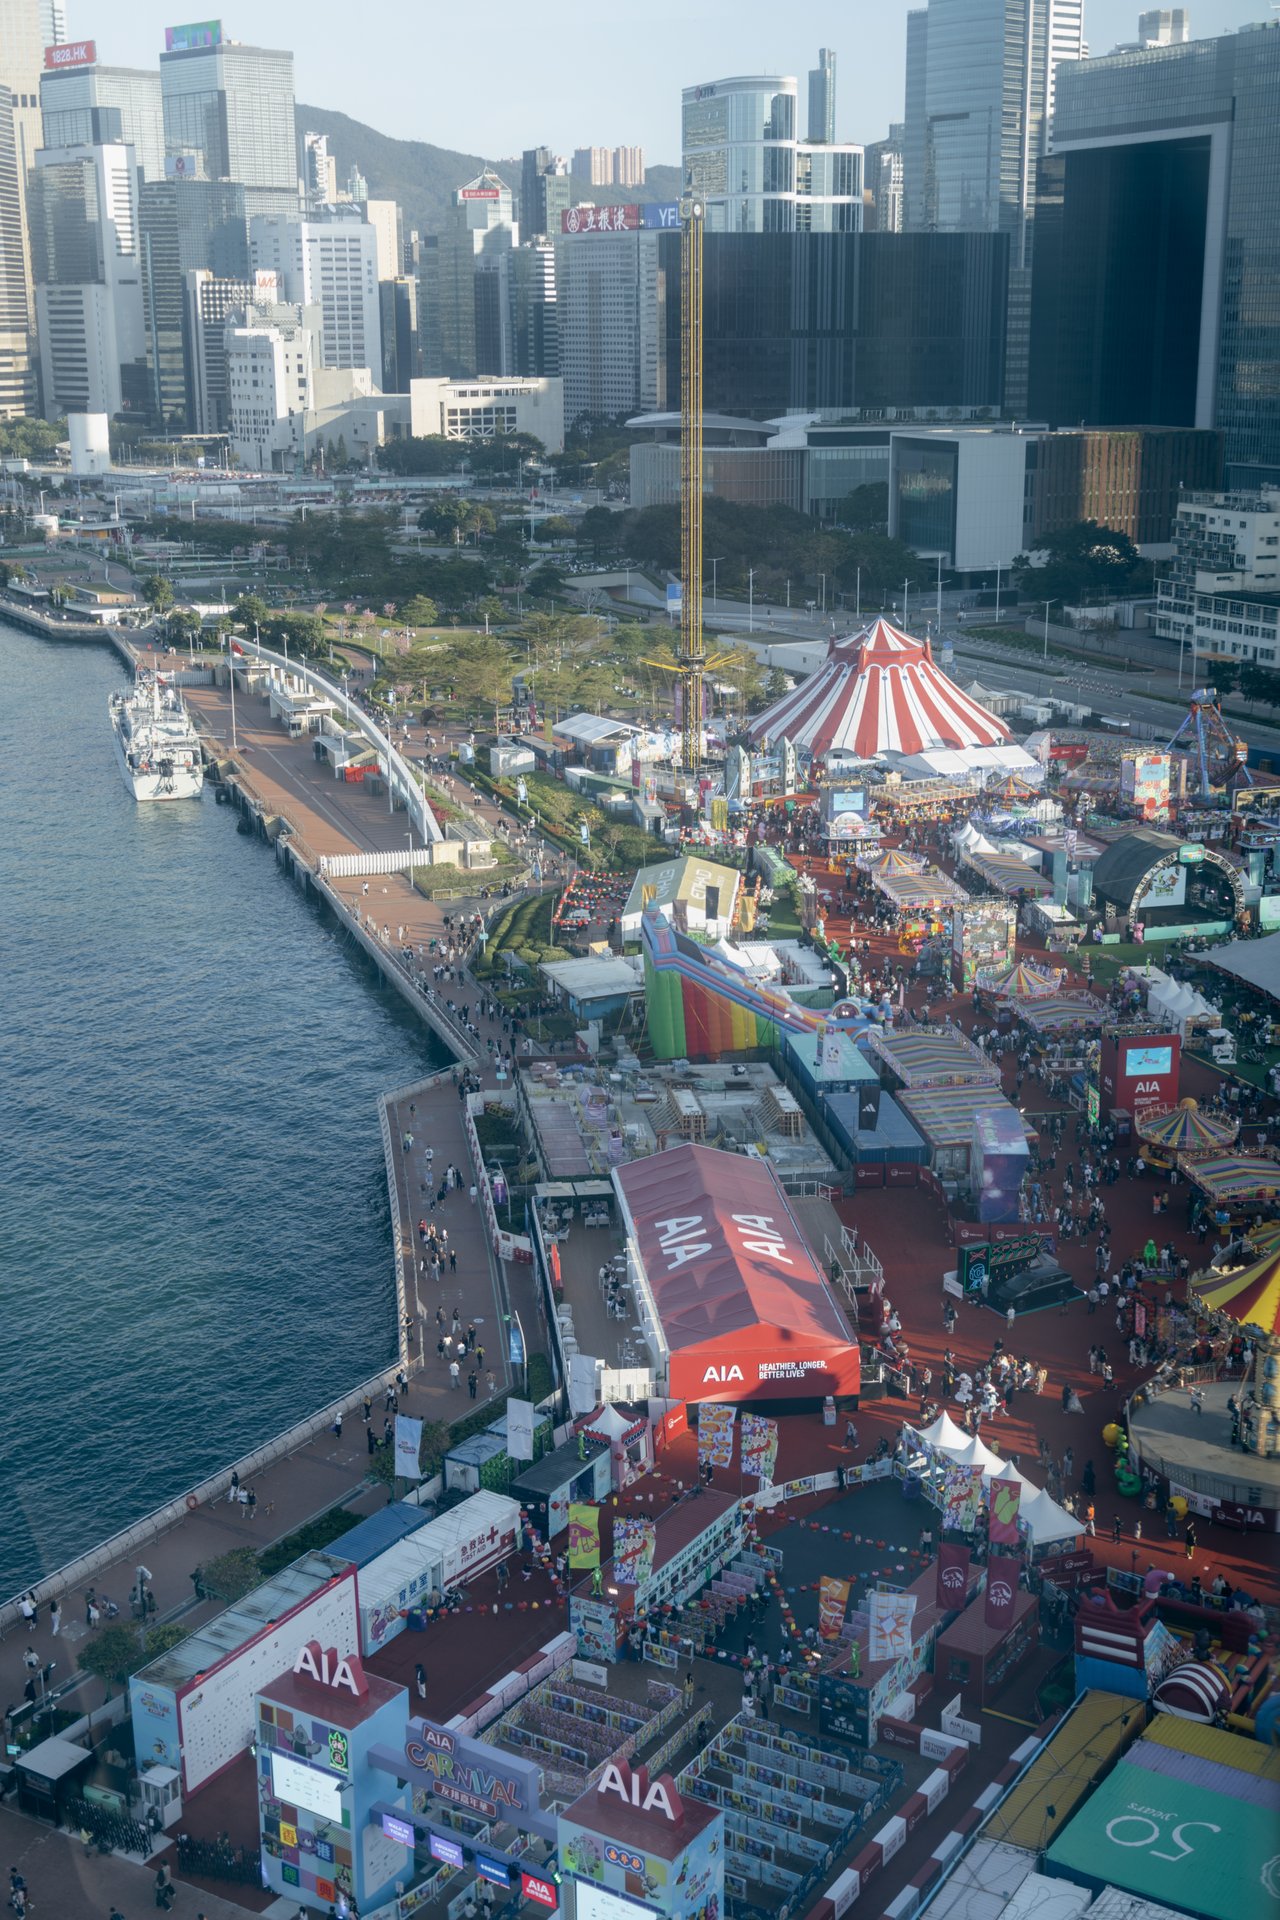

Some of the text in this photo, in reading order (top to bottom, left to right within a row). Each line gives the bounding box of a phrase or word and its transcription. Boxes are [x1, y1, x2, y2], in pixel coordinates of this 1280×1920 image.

[52, 45, 87, 64] 1828.HK
[1134, 1081, 1160, 1093] AIA
[654, 1215, 712, 1270] AIA
[731, 1214, 794, 1264] AIA
[703, 1365, 744, 1382] AIA
[758, 1360, 828, 1371] HEALTHIER, LONGER,
[758, 1370, 805, 1379] BETTER LIVES
[460, 1534, 485, 1557] 急救站
[461, 1544, 487, 1565] FIRST AID
[672, 1538, 702, 1568] TICKET OFFICE
[943, 1580, 962, 1588] AIA
[989, 1596, 1009, 1607] AIA
[293, 1646, 360, 1696] AIA
[426, 1731, 451, 1751] AIA
[406, 1742, 522, 1808] CARNIVAL
[440, 1785, 489, 1812] 友邦嘉年華
[597, 1764, 676, 1821] AIA
[1127, 1801, 1178, 1821] years
[390, 1829, 408, 1840] TICKET
[1106, 1815, 1222, 1862] 50
[434, 1842, 459, 1856] ADVANCE
[438, 1849, 456, 1860] TICKET
[528, 1880, 550, 1896] AIA
